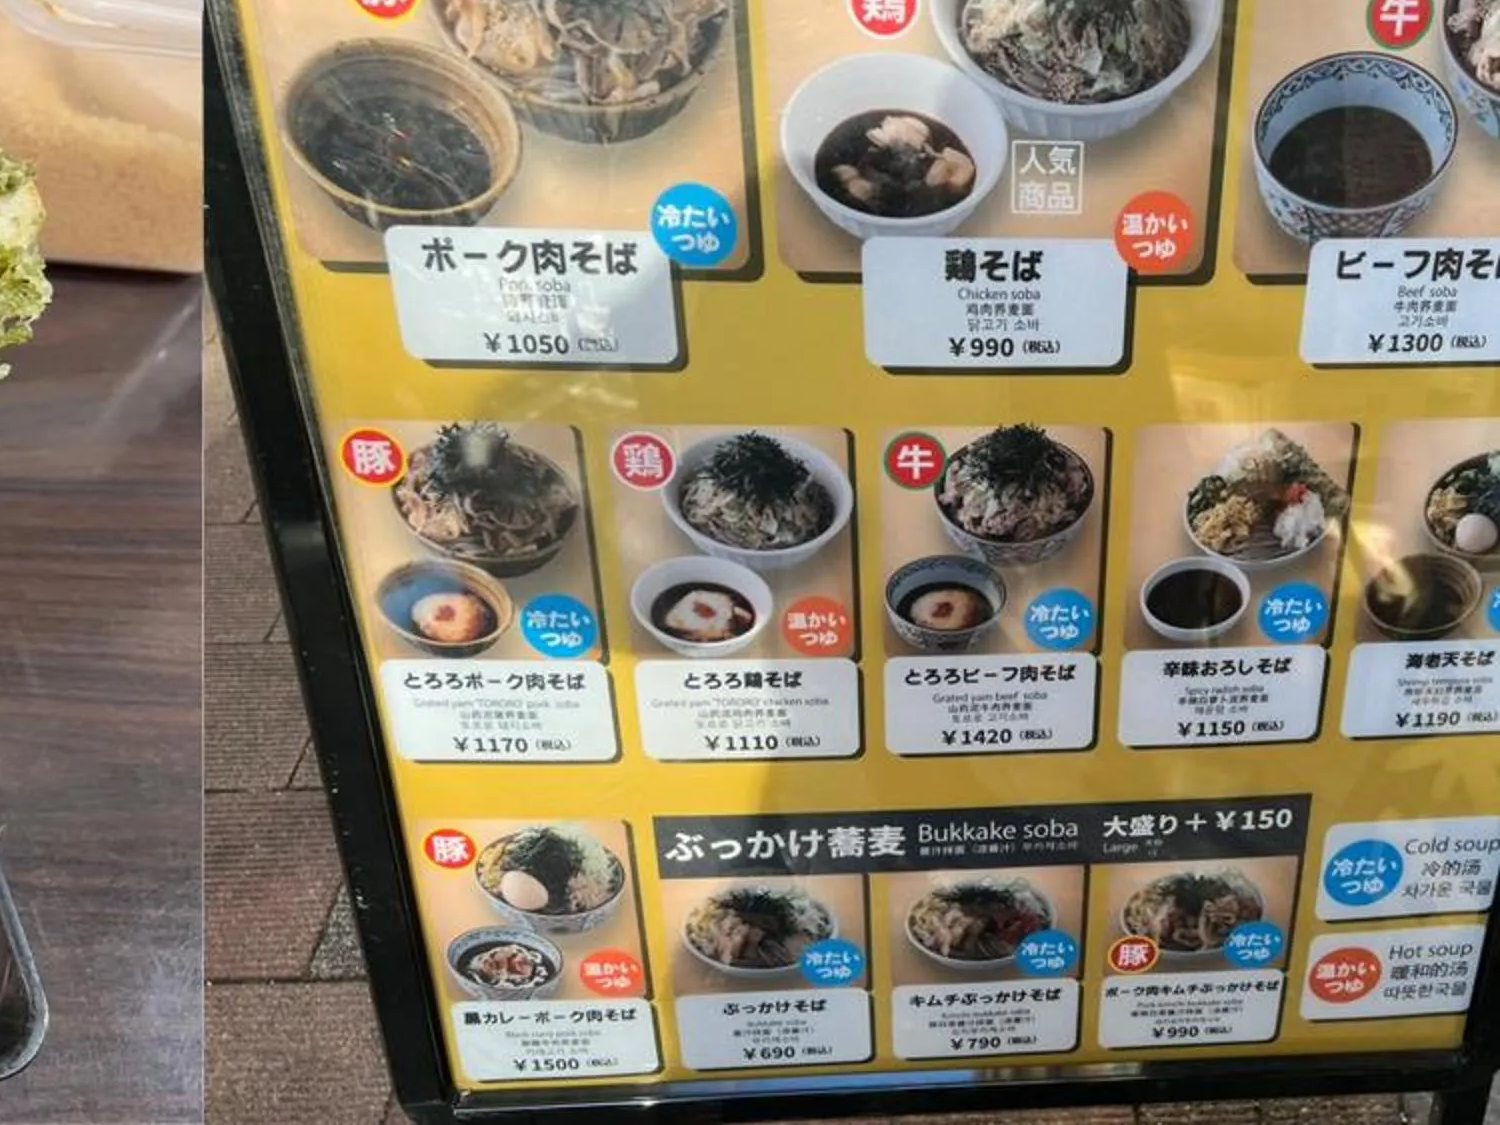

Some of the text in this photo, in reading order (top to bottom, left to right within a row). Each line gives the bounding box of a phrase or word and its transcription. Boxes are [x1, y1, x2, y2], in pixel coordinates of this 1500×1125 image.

[1019, 147, 1078, 175] 人気
[1019, 181, 1077, 211] 商品
[658, 203, 731, 229] 冷たい
[1121, 212, 1189, 235] 温かい
[672, 234, 721, 254] つゆ
[1132, 238, 1177, 260] つゆ
[421, 236, 639, 276] ポーク肉そば
[944, 248, 1043, 283] 鶏そば
[1336, 247, 1500, 282] ビーフ肉そ
[957, 287, 1041, 301] Chicken soba
[1397, 285, 1459, 298] Beef soba
[351, 437, 395, 475] 豚
[897, 443, 935, 479] 牛
[1030, 600, 1090, 622] 冷たい
[1264, 595, 1325, 617] 冷たい
[526, 610, 591, 630] 冷たい
[1274, 614, 1312, 634] つゆ
[539, 630, 582, 649] つゆ
[799, 630, 838, 648] つゆ
[1041, 620, 1080, 641] つゆ
[1405, 650, 1496, 670] 海老天そば
[403, 671, 586, 691] とろろポーク肉そば
[904, 664, 1077, 687] とろろビーフ肉そば
[918, 819, 1079, 843] Bukkake soba
[666, 824, 907, 863] ぶっかけ蕎麦
[1404, 836, 1500, 857] Cold soup
[1331, 858, 1397, 877] 冷たい
[1340, 877, 1384, 894] つゆ
[1021, 940, 1075, 958] 冷たい
[1227, 933, 1282, 951] 冷たい
[1389, 943, 1473, 960] Hot soup
[806, 952, 860, 967] 冷たい
[1030, 956, 1065, 971] つゆ
[1239, 948, 1273, 964] つゆ
[596, 974, 632, 989] つゆ
[816, 965, 851, 981] つゆ
[1324, 978, 1364, 994] つゆ
[723, 998, 828, 1016] ぶっかけそば
[909, 988, 1062, 1008] キムチぶっかけそば
